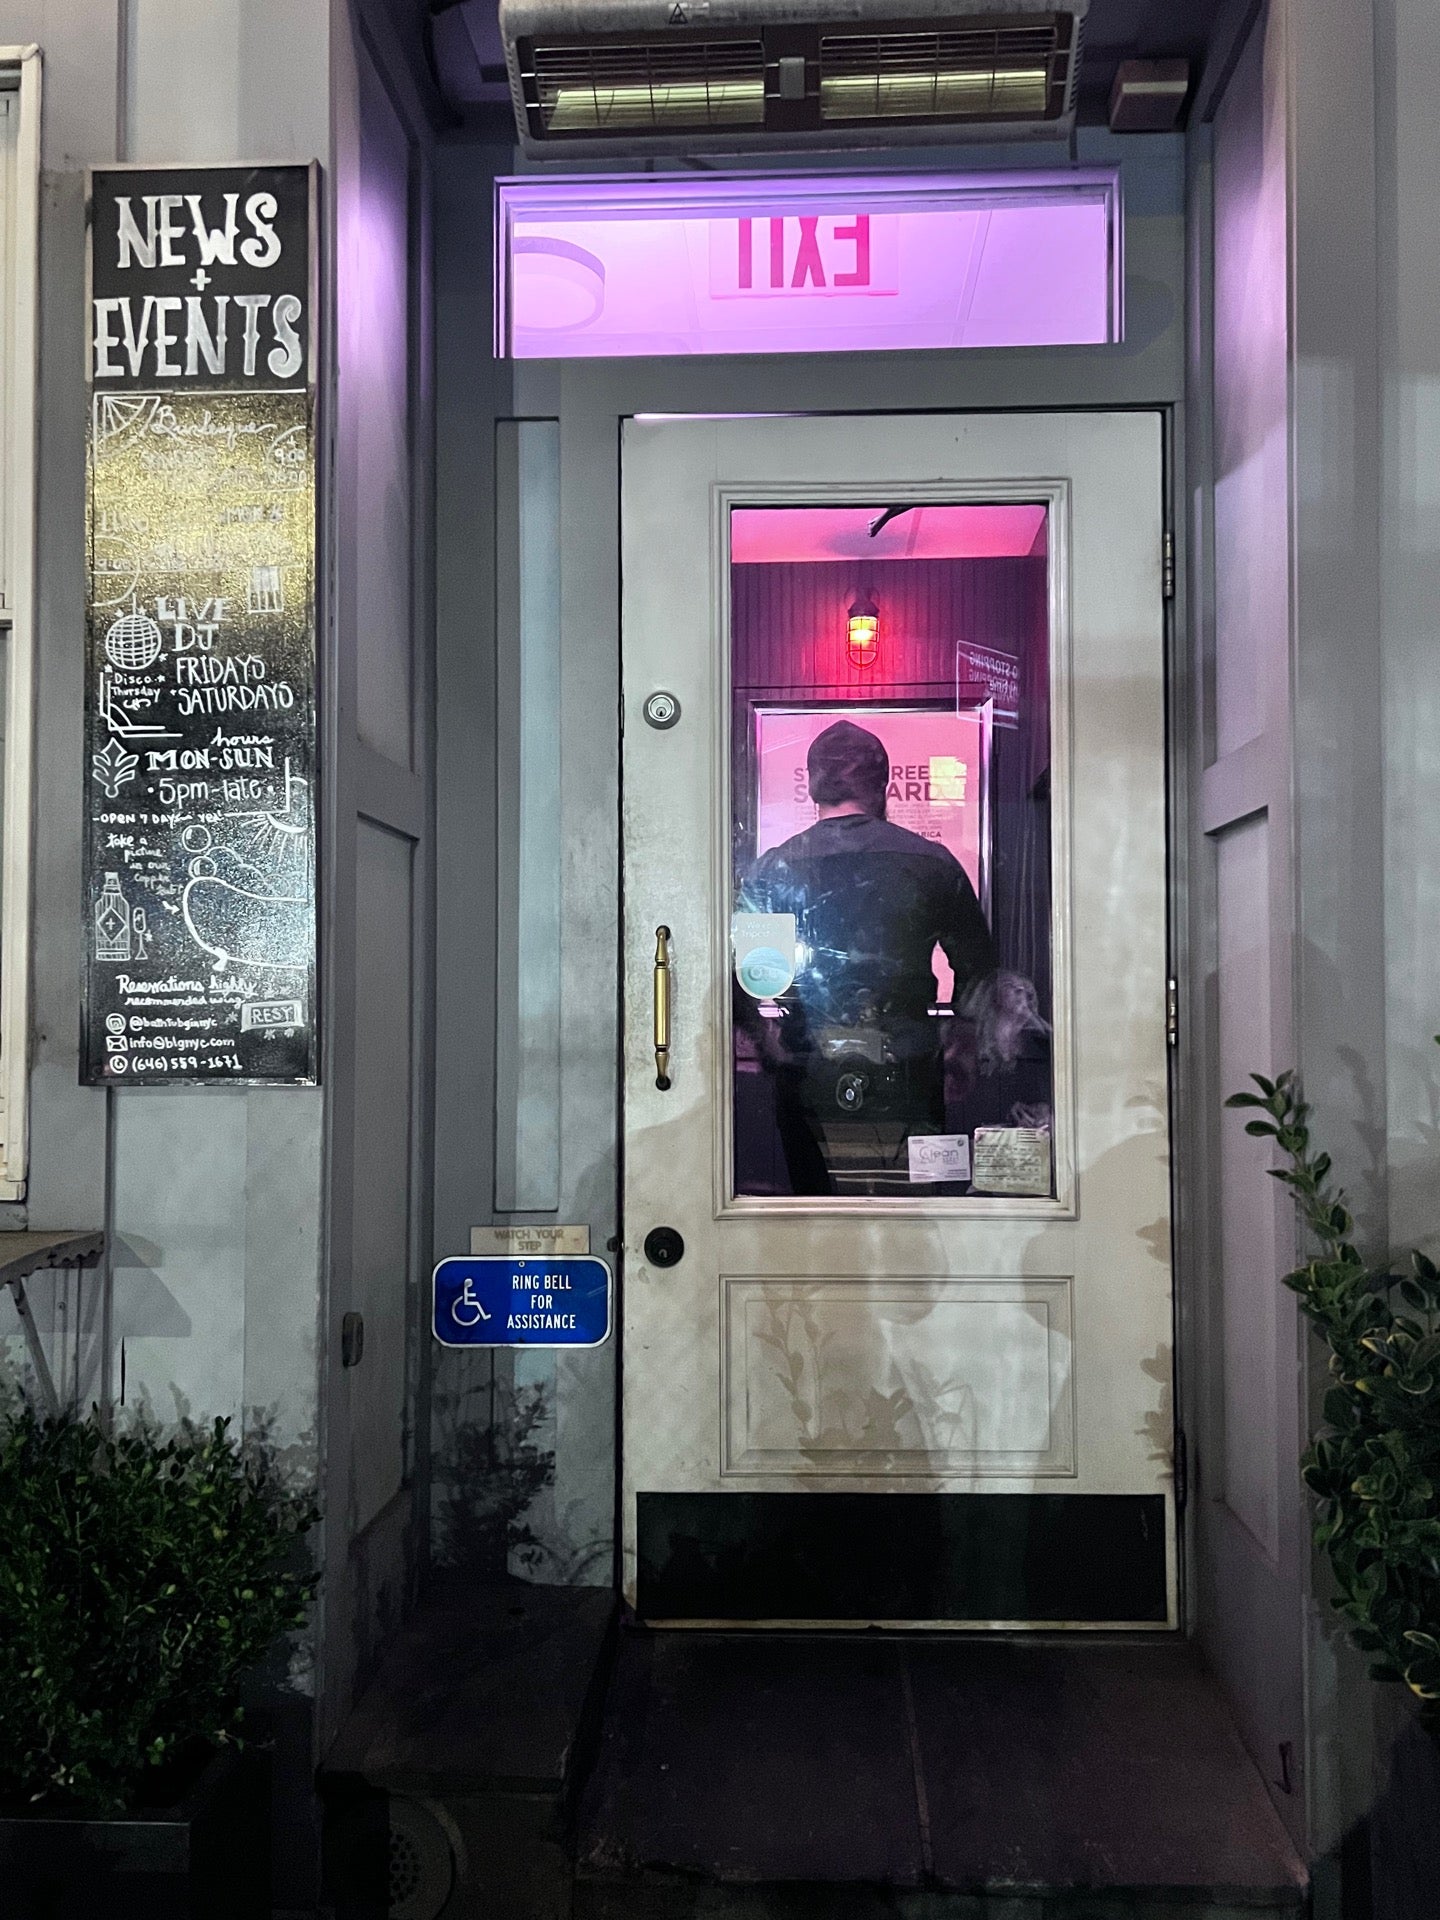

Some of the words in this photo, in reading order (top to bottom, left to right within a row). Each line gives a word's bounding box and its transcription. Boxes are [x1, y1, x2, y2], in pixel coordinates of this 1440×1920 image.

[114, 192, 282, 268] NEWS
[93, 294, 303, 378] EVENTS
[155, 596, 232, 621] LIVE
[172, 623, 219, 651] DJ
[114, 672, 152, 685] Disco
[176, 654, 265, 685] FRIDAYS
[111, 685, 161, 703] Thursday
[178, 681, 294, 715] SATURDAYS
[210, 727, 275, 746] hours
[144, 747, 274, 771] MON-SUN
[140, 814, 149, 825] 7
[115, 974, 205, 994] Reservations
[209, 974, 258, 999] highly
[124, 995, 208, 1006] recommended
[252, 1006, 294, 1024] RESY
[132, 1055, 168, 1071] (646)
[494, 1229, 531, 1240] WATCH
[535, 1228, 565, 1240] YOUR
[517, 1240, 542, 1251] STEP
[512, 1274, 540, 1290] RING
[544, 1274, 572, 1290] BELL
[531, 1294, 553, 1310] FOR
[506, 1314, 576, 1330] ASSISTANCE
